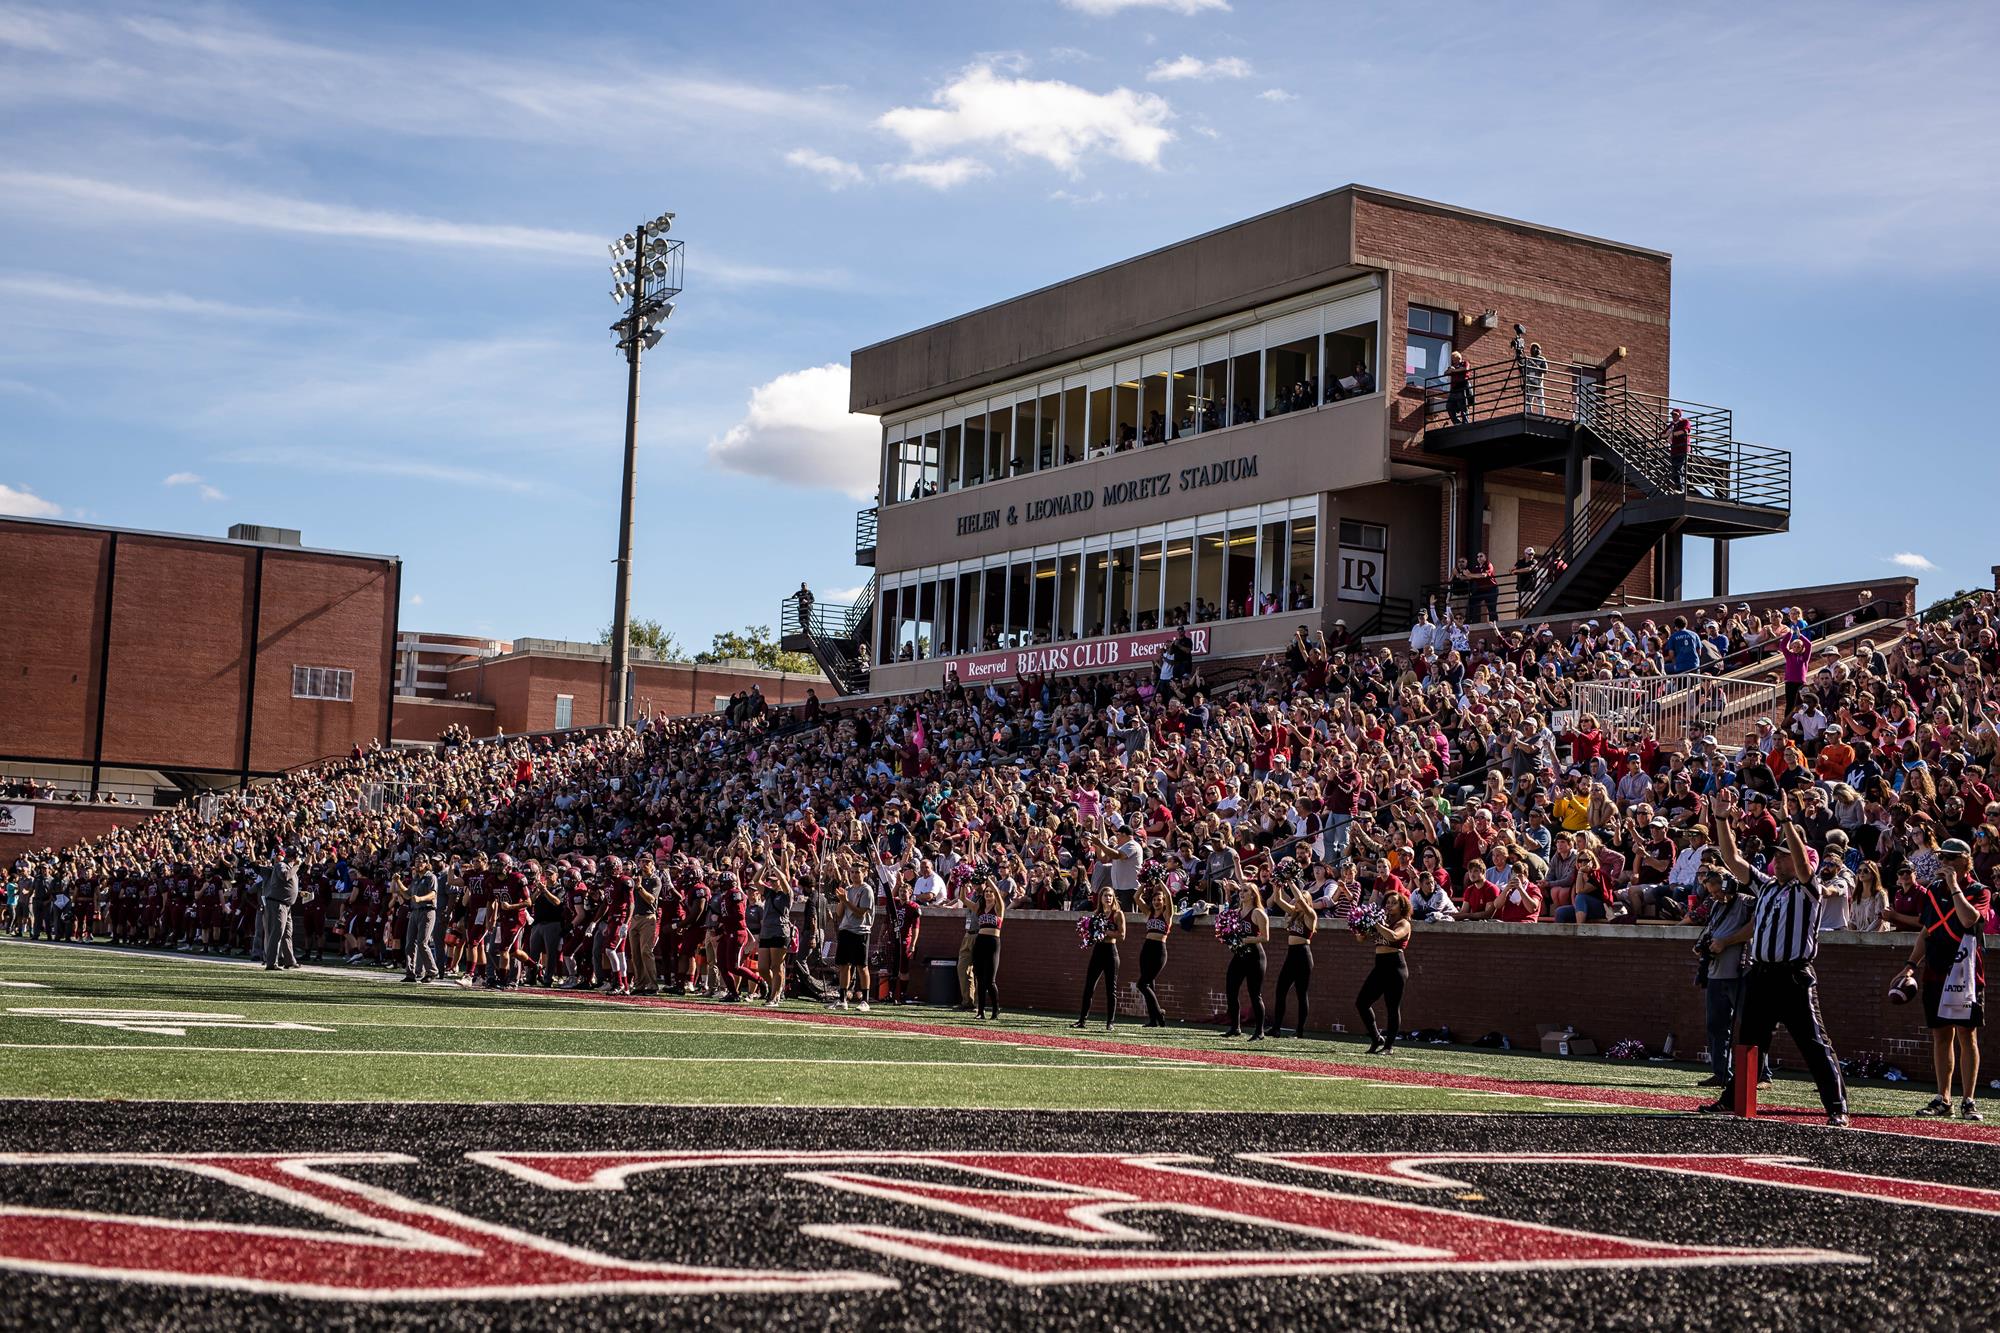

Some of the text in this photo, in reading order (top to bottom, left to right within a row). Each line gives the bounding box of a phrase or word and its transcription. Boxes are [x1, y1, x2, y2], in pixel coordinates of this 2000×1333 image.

[956, 454, 1258, 537] HELEN & LEONARD MORETZ STADIUM
[1341, 556, 1380, 596] LR
[968, 658, 1007, 676] Reserved
[1017, 646, 1069, 674] BEARS
[1073, 641, 1119, 668] CLUB
[1130, 636, 1177, 658] Reserv
[1846, 769, 1865, 789] NY
